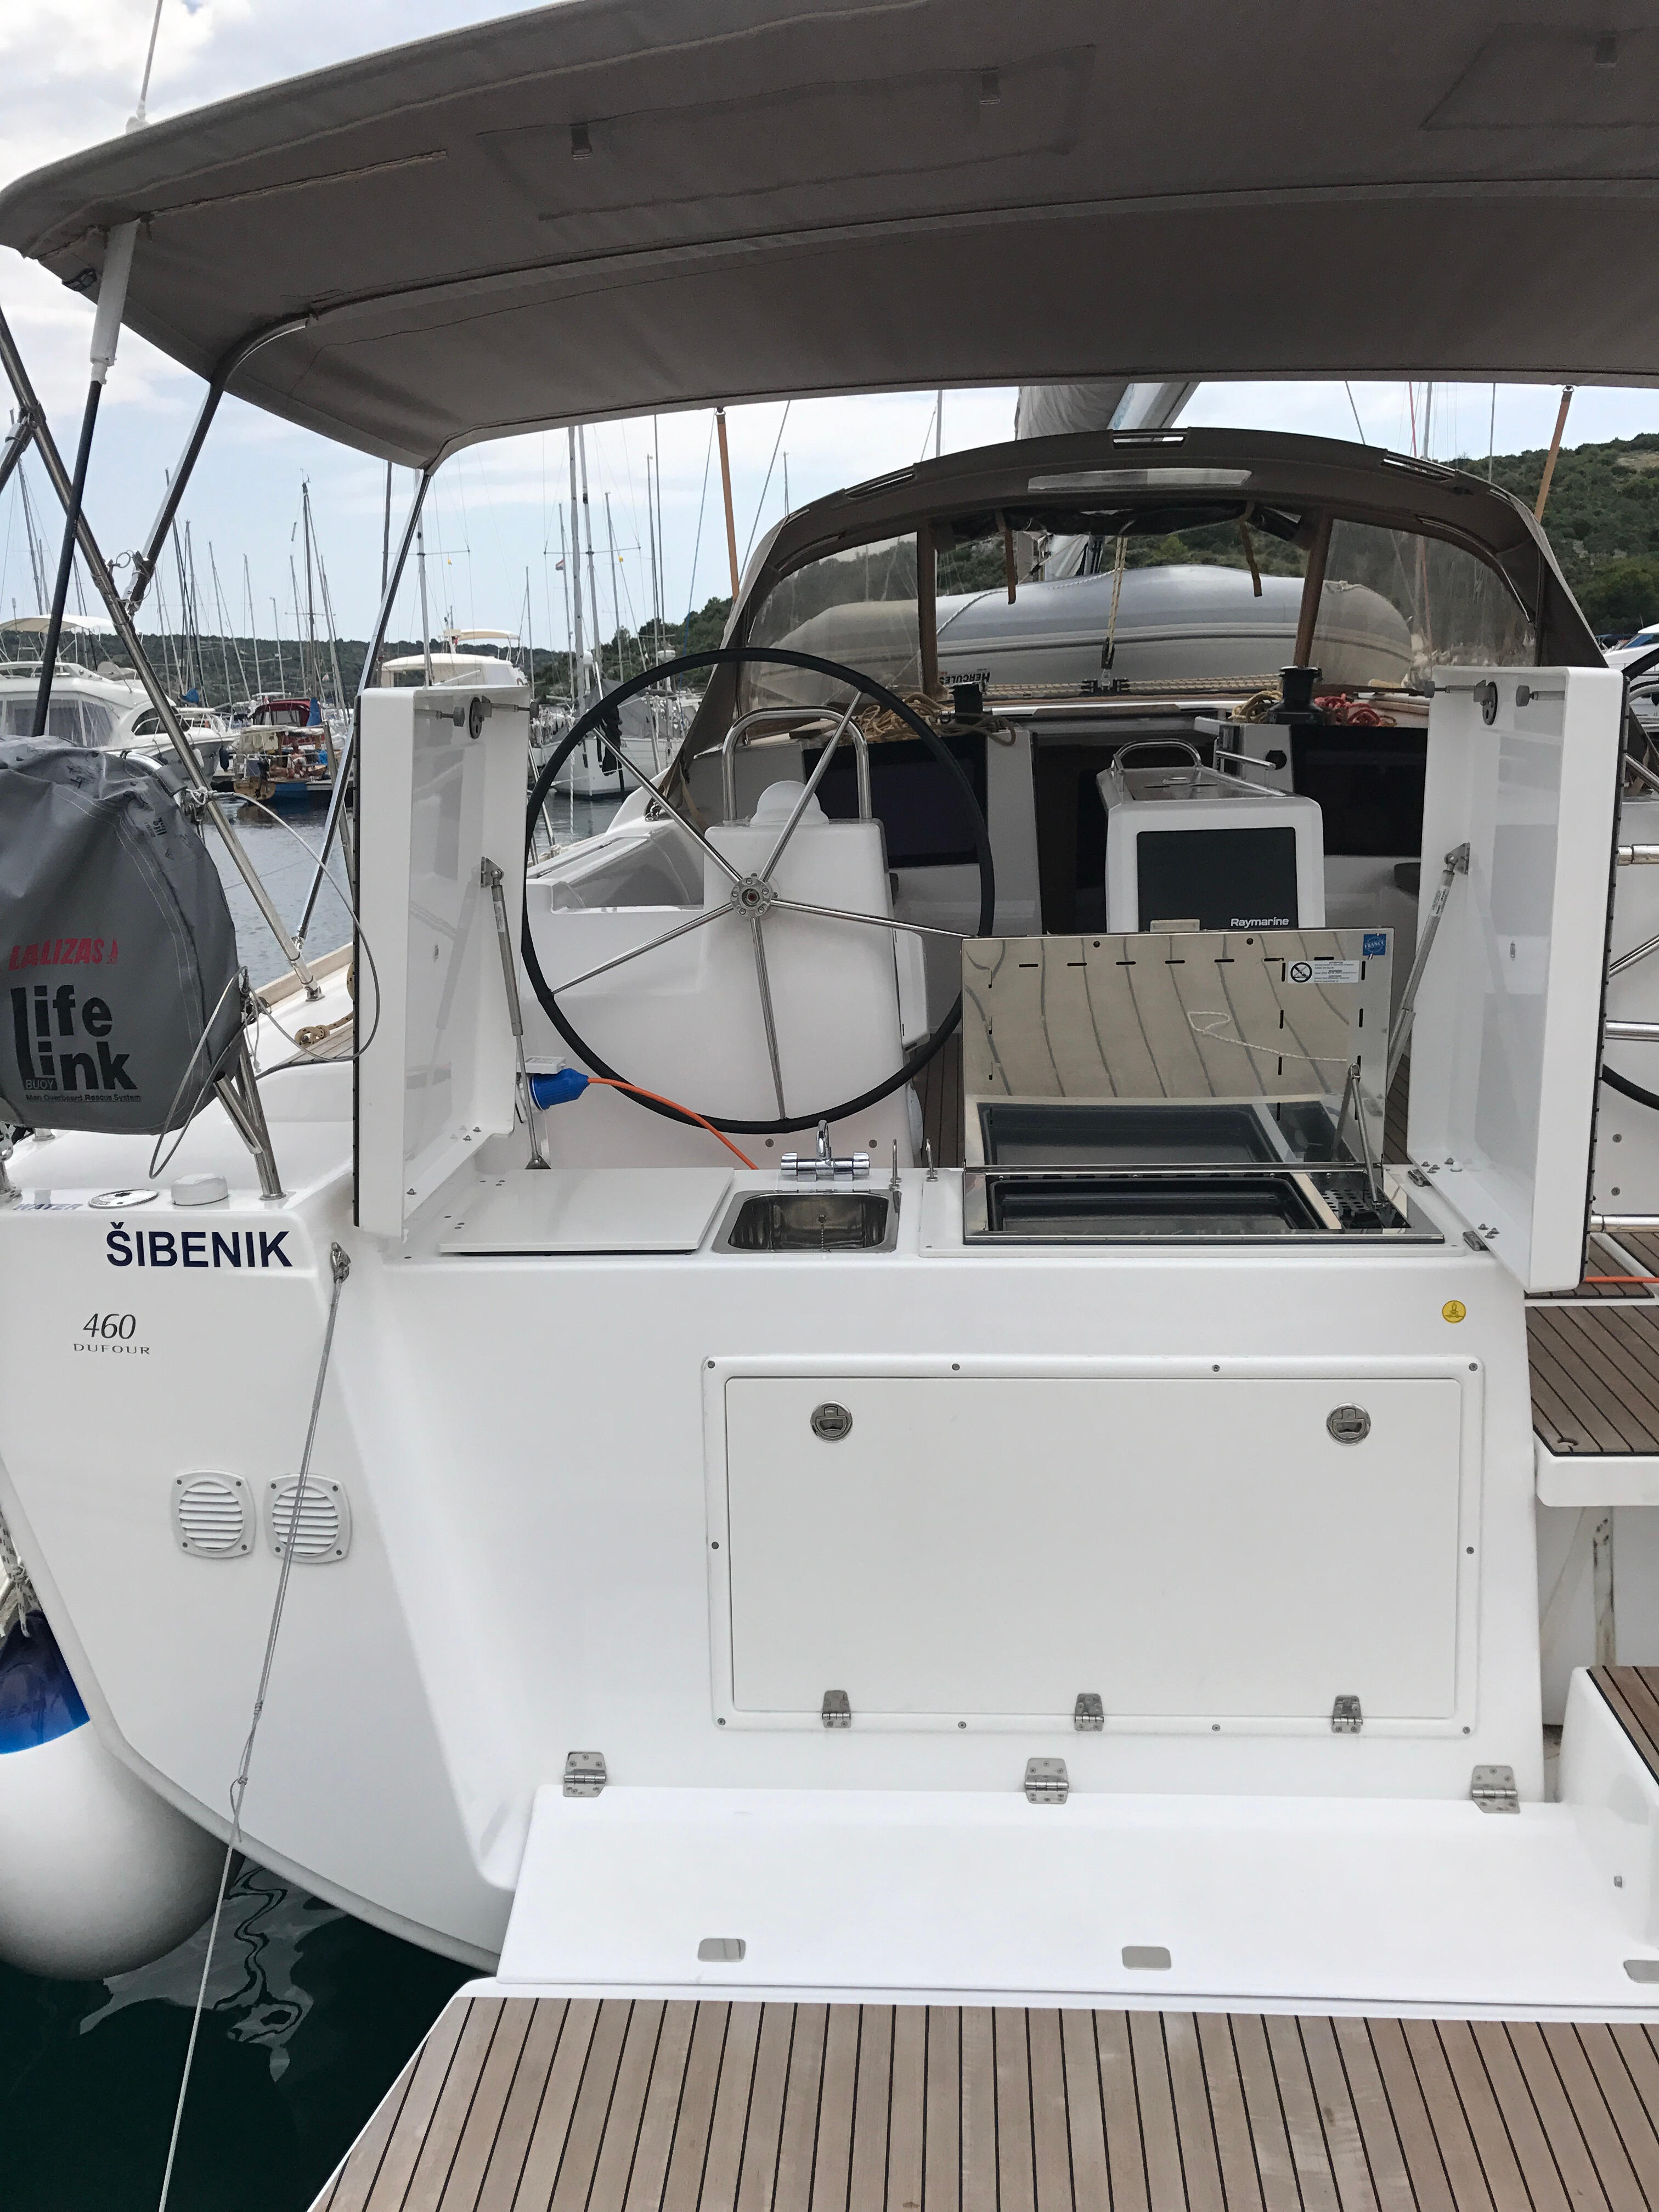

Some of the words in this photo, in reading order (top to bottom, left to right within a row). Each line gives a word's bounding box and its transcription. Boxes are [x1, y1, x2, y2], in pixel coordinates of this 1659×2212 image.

[939, 672, 990, 685] HERCULES
[1231, 916, 1289, 928] Raymarine
[8, 938, 105, 971] LALIZAS
[25, 1079, 54, 1090] BUOY
[114, 1094, 141, 1102] System
[106, 1222, 293, 1267] ŠIBENIK
[83, 1313, 136, 1339] 460
[73, 1343, 150, 1355] DUFOUR
